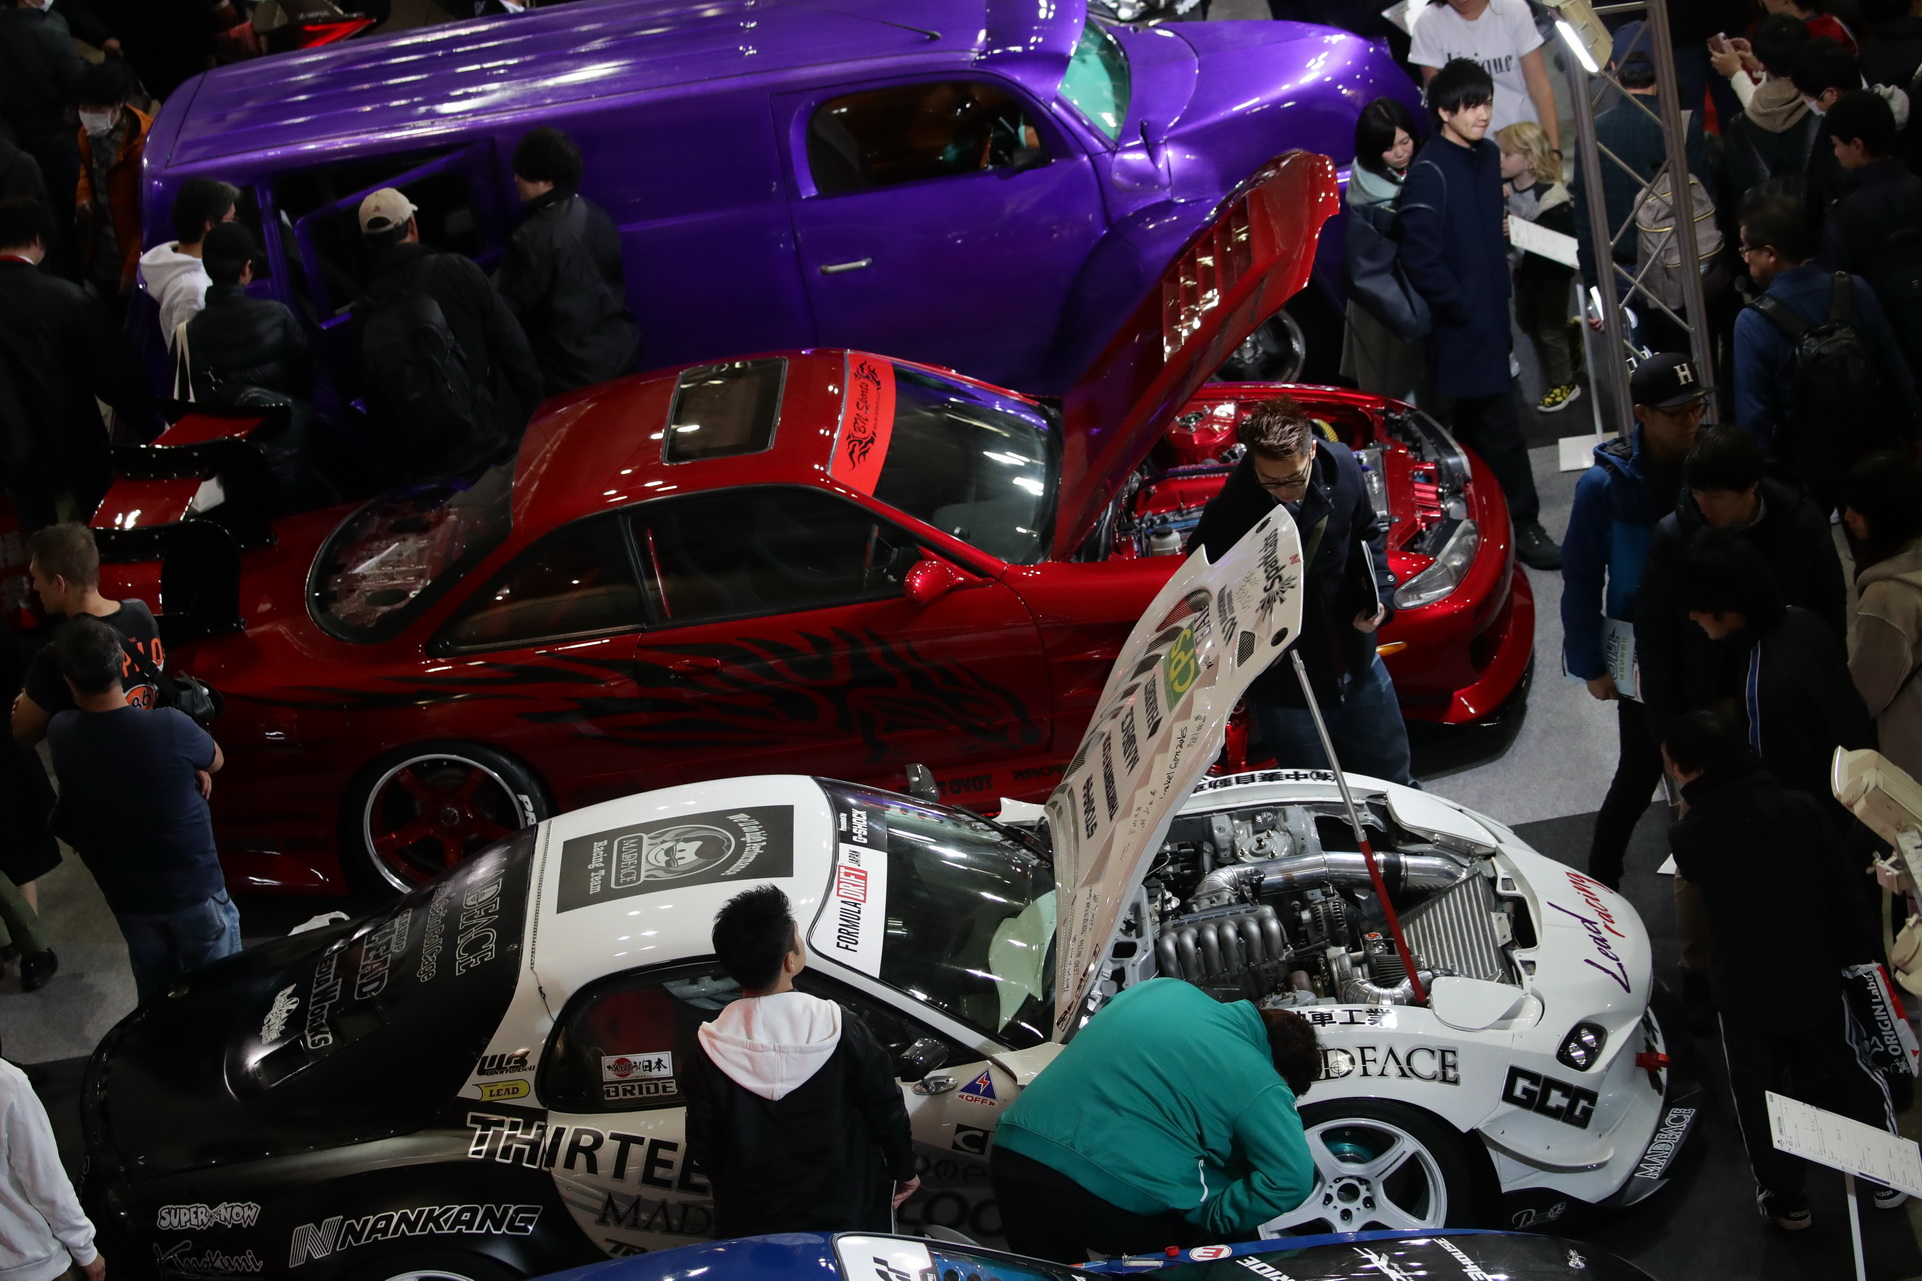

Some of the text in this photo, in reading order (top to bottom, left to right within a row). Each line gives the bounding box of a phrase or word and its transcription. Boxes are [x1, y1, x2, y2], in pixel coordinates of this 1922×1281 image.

[1673, 362, 1694, 386] H
[851, 808, 868, 844] G-SHOCK
[588, 839, 608, 895] Racing Team
[619, 838, 639, 885] MADFACE
[836, 849, 867, 953] FORMULA DRIFT JAPAN
[1546, 871, 1631, 994] Lead racing
[1866, 972, 1902, 1056] ORIGIN Labo.
[488, 1086, 520, 1099] LEAD
[603, 1080, 678, 1100] BRIDE
[1634, 1108, 1697, 1180] MADFACE
[157, 1201, 261, 1231] SUPER NOW
[336, 1204, 543, 1251] NANKANG
